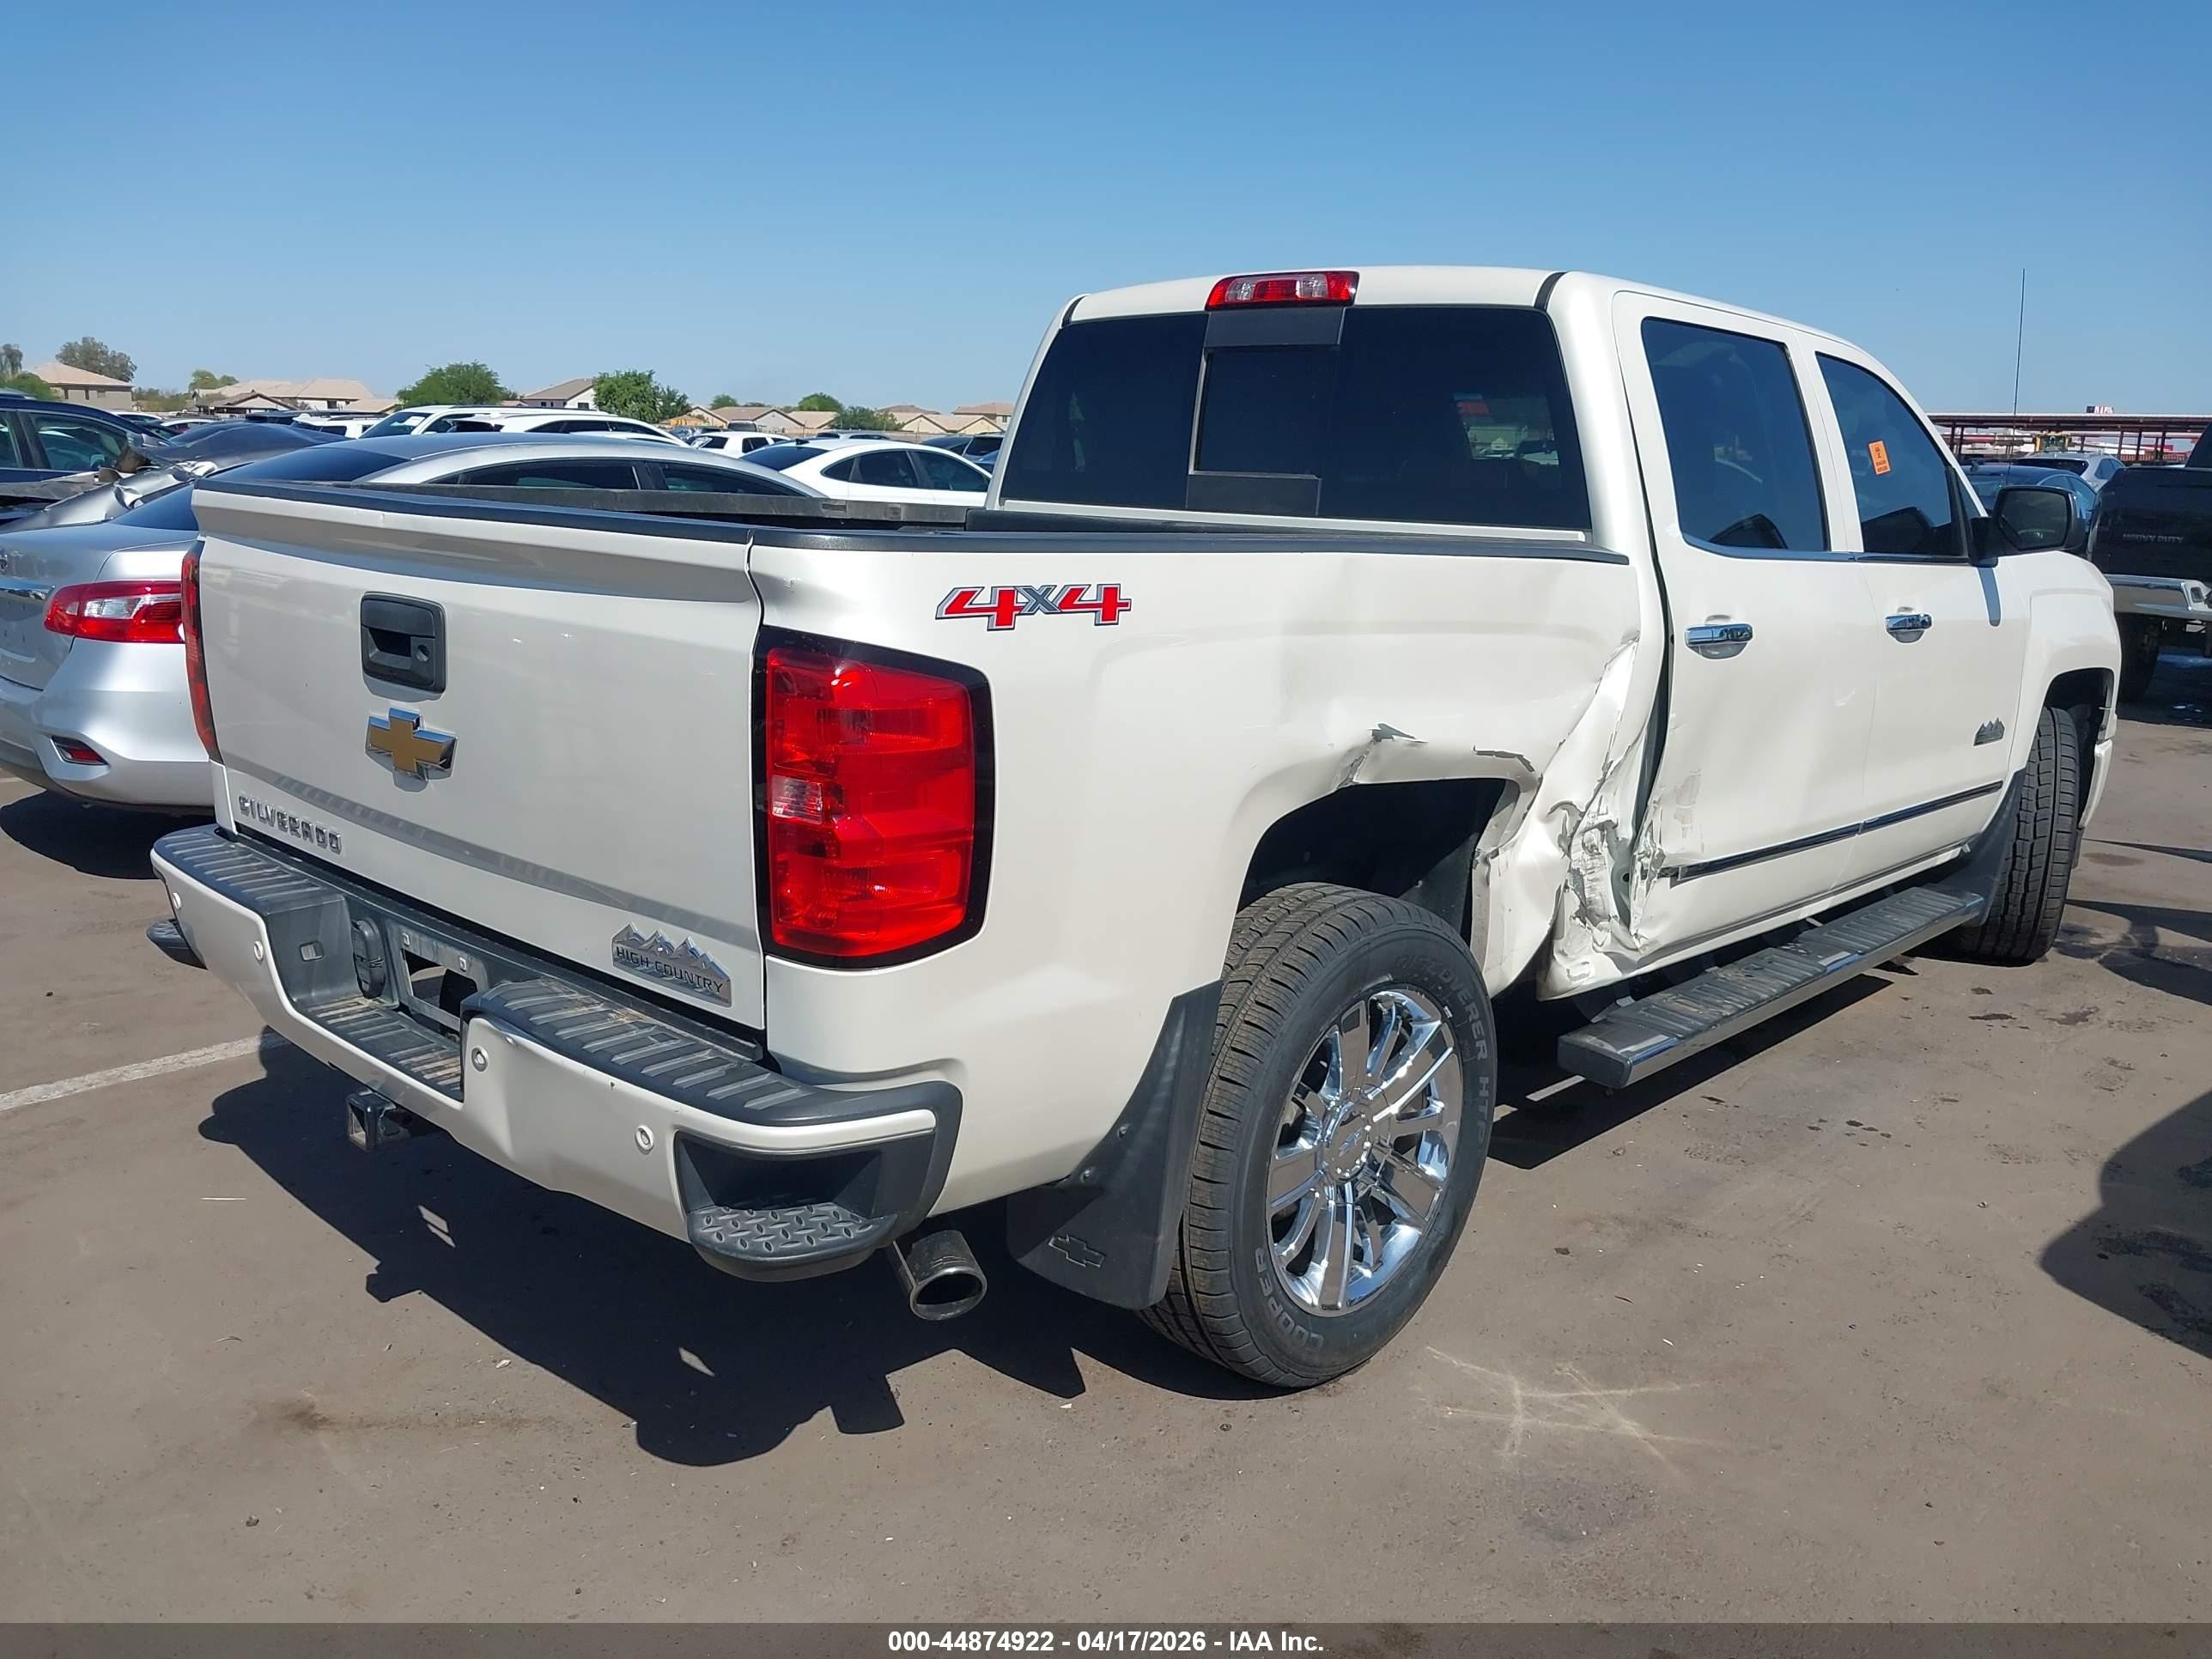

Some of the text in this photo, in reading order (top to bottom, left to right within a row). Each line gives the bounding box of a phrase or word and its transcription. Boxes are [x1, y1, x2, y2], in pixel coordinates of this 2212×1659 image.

[239, 796, 342, 854] SILVERADO
[616, 946, 724, 994] HIGH COUNTRY
[1255, 1247, 1325, 1352] COOPER
